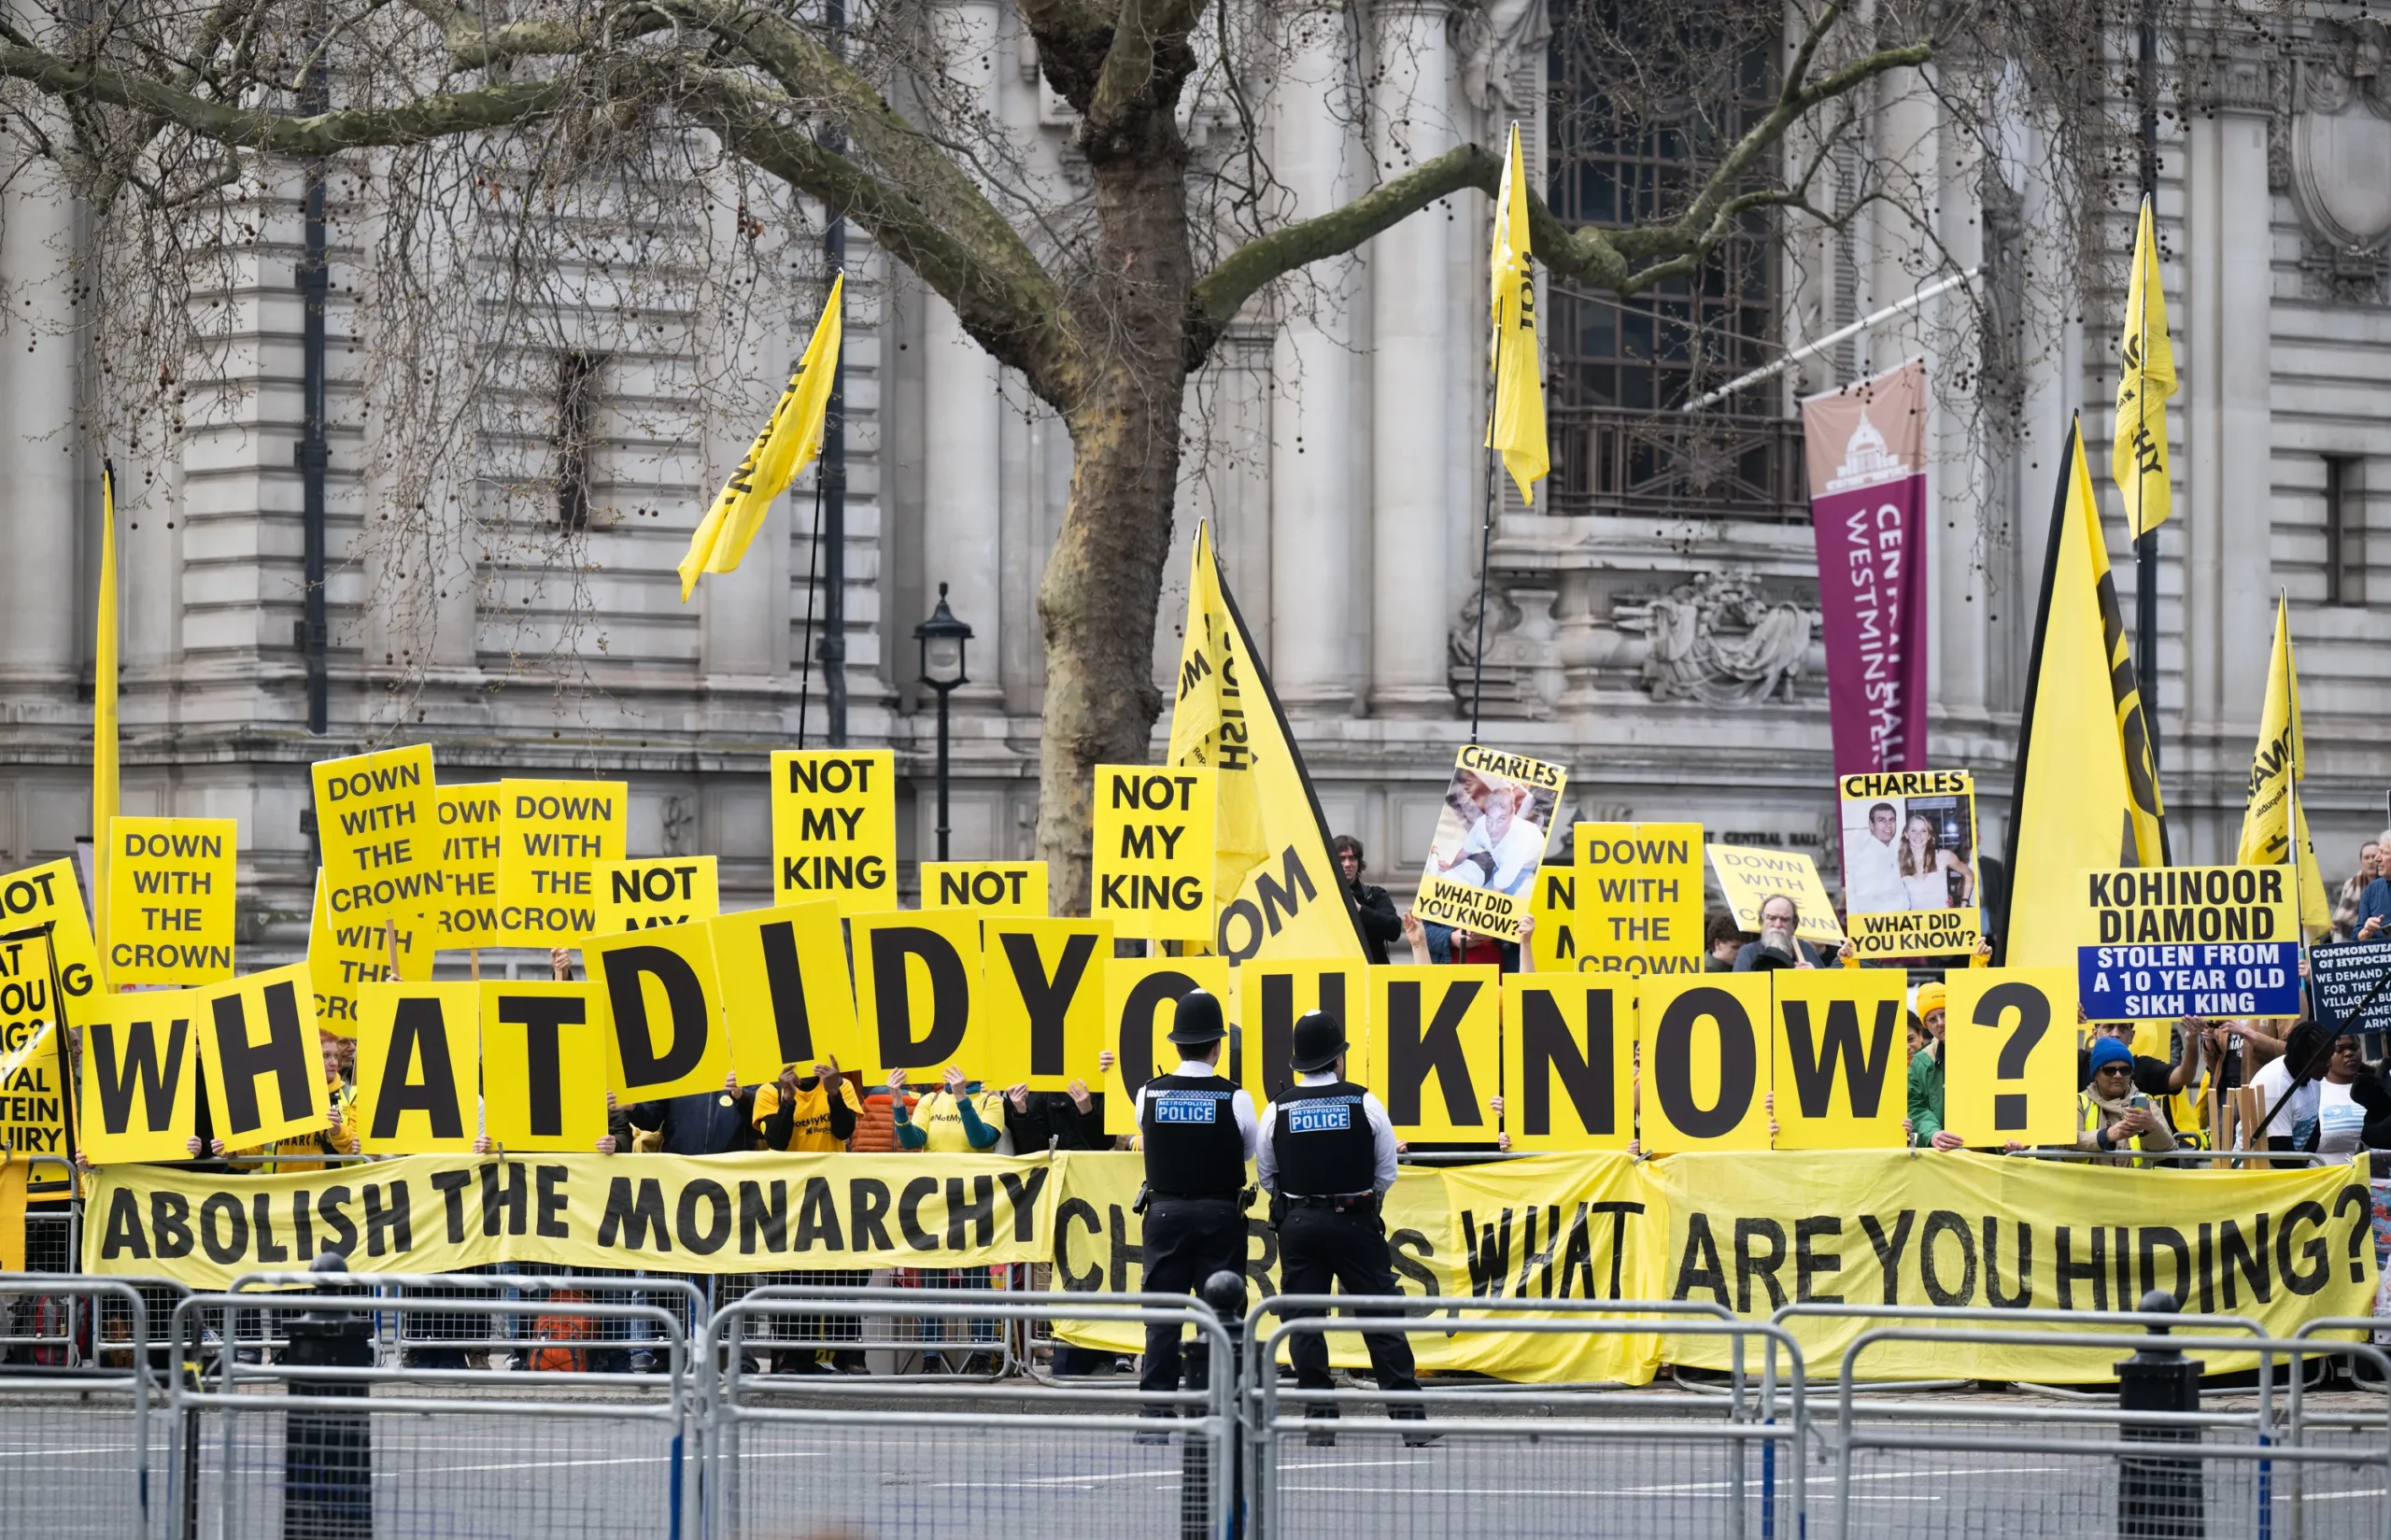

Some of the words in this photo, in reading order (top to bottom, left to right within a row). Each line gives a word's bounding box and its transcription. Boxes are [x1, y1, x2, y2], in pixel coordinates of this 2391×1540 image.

[789, 759, 875, 794] NOT
[1462, 746, 1559, 787] CHARLES
[328, 762, 420, 801] DOWN
[1112, 774, 1198, 812] NOT
[1846, 771, 1965, 798] CHARLES
[340, 800, 417, 836] WITH
[438, 800, 501, 825] OWN
[516, 796, 611, 821] DOWN
[801, 807, 866, 841] MY
[125, 834, 221, 858] DOWN
[353, 839, 413, 870] THE
[524, 833, 601, 857] WITH
[1121, 825, 1186, 860] MY
[1590, 840, 1689, 865] DOWN
[783, 855, 886, 891] KING
[1724, 854, 1804, 874] DOWN
[134, 871, 211, 895] WITH
[332, 869, 444, 912] CROWN
[446, 872, 496, 896] HE
[531, 870, 591, 894] THE
[612, 867, 698, 904] NOT
[940, 870, 1028, 905] NOT
[1100, 875, 1204, 911] KING
[1598, 879, 1679, 903] WITH
[1738, 872, 1804, 892] WITH
[2089, 869, 2284, 908] KOHINOOR
[1434, 882, 1483, 908] WHAT
[1486, 896, 1513, 915] DID
[1754, 892, 1805, 910] TE
[141, 908, 202, 931] THE
[502, 907, 595, 933] CROW
[1418, 896, 1455, 920] YOU
[1456, 906, 1521, 937] KNOW?
[1608, 917, 1670, 941] THE
[1738, 908, 1838, 930] CWN
[1864, 915, 1922, 934] WHAT
[1929, 912, 1961, 929] DID
[2100, 906, 2274, 943] DIAMOND
[336, 925, 412, 954] WITH
[1851, 935, 1894, 953] YOU
[1900, 930, 1976, 951] KNOW?
[111, 944, 231, 968] CROWN
[1578, 954, 1700, 975] CROWN
[2098, 946, 2194, 968] STOLEN
[2204, 944, 2279, 965] FROM
[2319, 959, 2334, 968] OF
[2093, 972, 2111, 992] A
[2119, 970, 2150, 992] 10
[2159, 969, 2227, 990] YEAR
[2235, 968, 2285, 989] OLD
[2315, 972, 2332, 983] WE
[2335, 968, 2383, 982] DEMAND
[2324, 984, 2346, 996] FOR
[2351, 982, 2372, 992] THE
[2125, 994, 2186, 1016] SIKH
[2195, 992, 2256, 1013] KING
[91, 980, 587, 1138] WHAT
[601, 921, 969, 1090] DID
[1388, 981, 1900, 1139] KNOW
[1158, 1107, 1213, 1122] POLICE
[1292, 1107, 1347, 1116] METROPOLITAN
[1292, 1113, 1348, 1131] POLICE
[101, 1180, 412, 1264] ABOLISH
[431, 1162, 569, 1244] THE
[597, 1166, 1050, 1256] MONARCHY
[1461, 1201, 1646, 1299] WHAT
[1673, 1213, 1845, 1313] ARE
[1858, 1209, 2032, 1310] YOU
[2057, 1183, 2372, 1315] HIDING?
